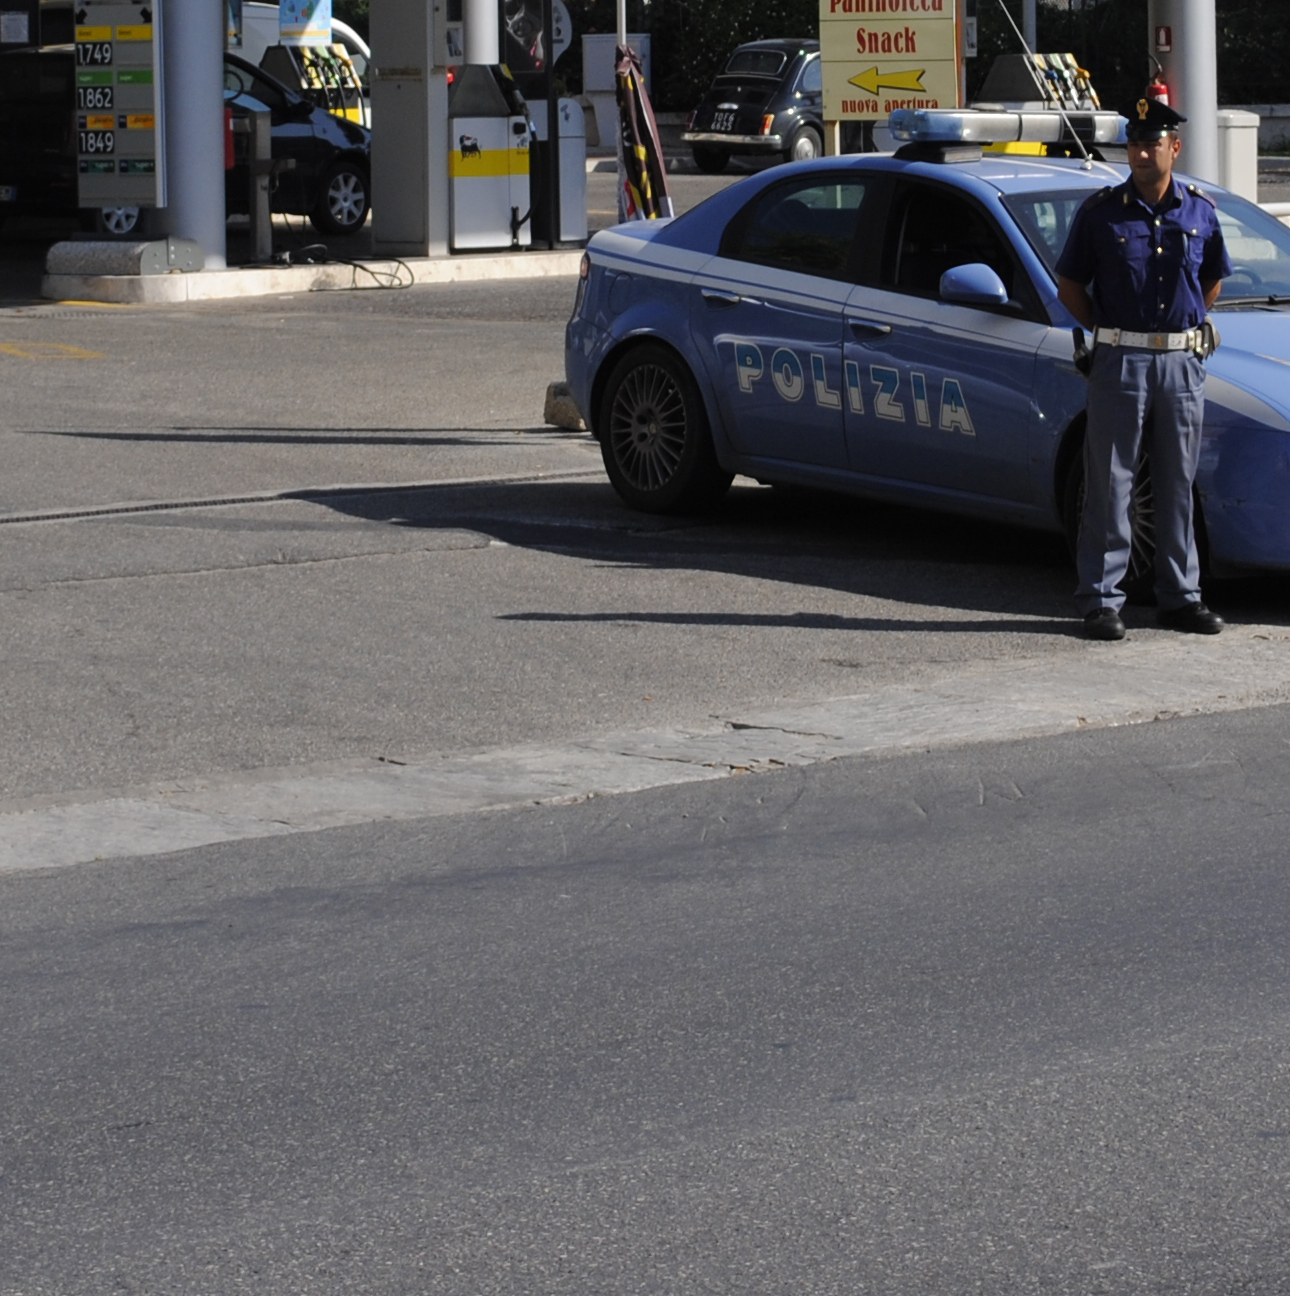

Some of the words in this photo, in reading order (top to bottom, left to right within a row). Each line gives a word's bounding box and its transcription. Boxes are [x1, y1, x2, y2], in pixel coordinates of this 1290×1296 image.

[856, 26, 917, 54] Snack
[841, 98, 879, 113] nuova
[734, 342, 977, 436] POLIZIA
